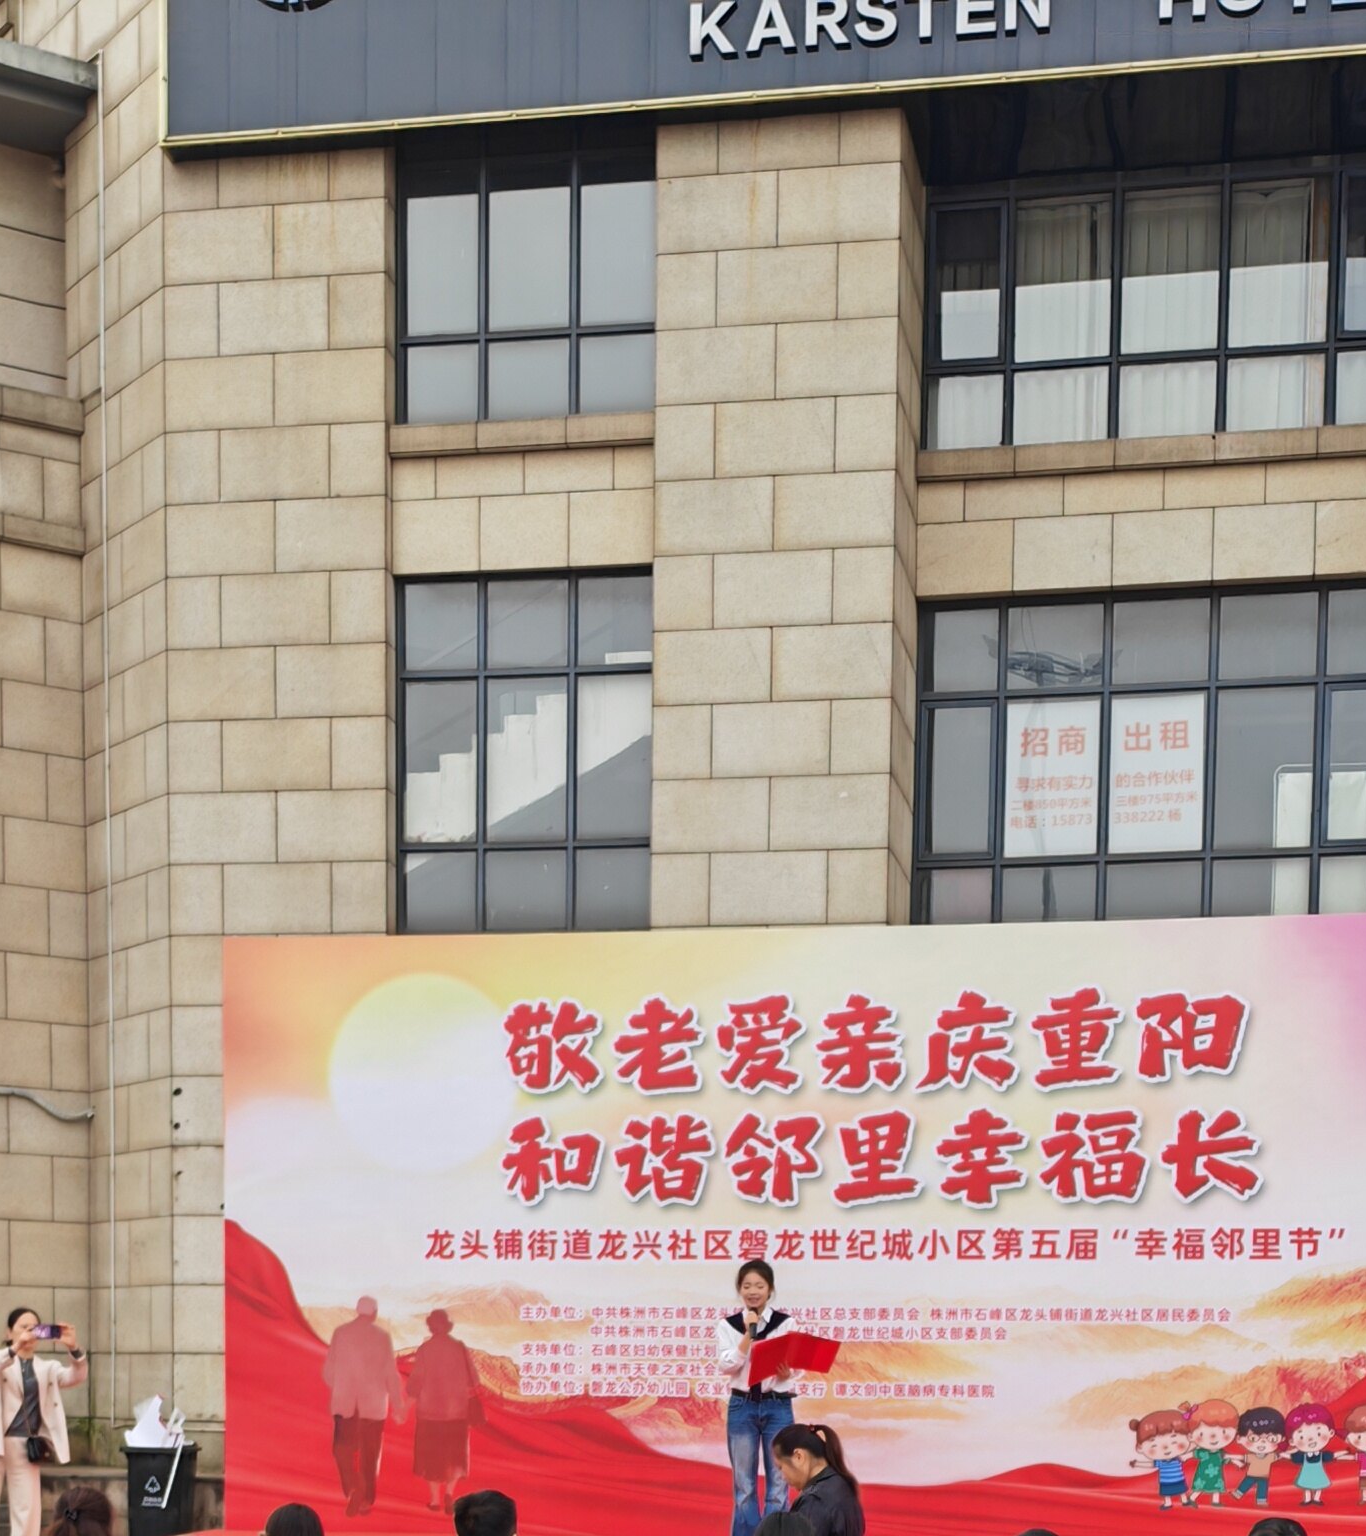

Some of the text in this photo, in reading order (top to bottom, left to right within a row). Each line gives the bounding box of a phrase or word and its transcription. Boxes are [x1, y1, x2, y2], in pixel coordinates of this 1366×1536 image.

[689, 0, 1051, 56] KARSTEN
[1021, 719, 1190, 758] 招商 出租
[502, 988, 1247, 1092] 敬老爱亲庆重阳
[501, 1109, 1261, 1204] 和谐邻里幸福长
